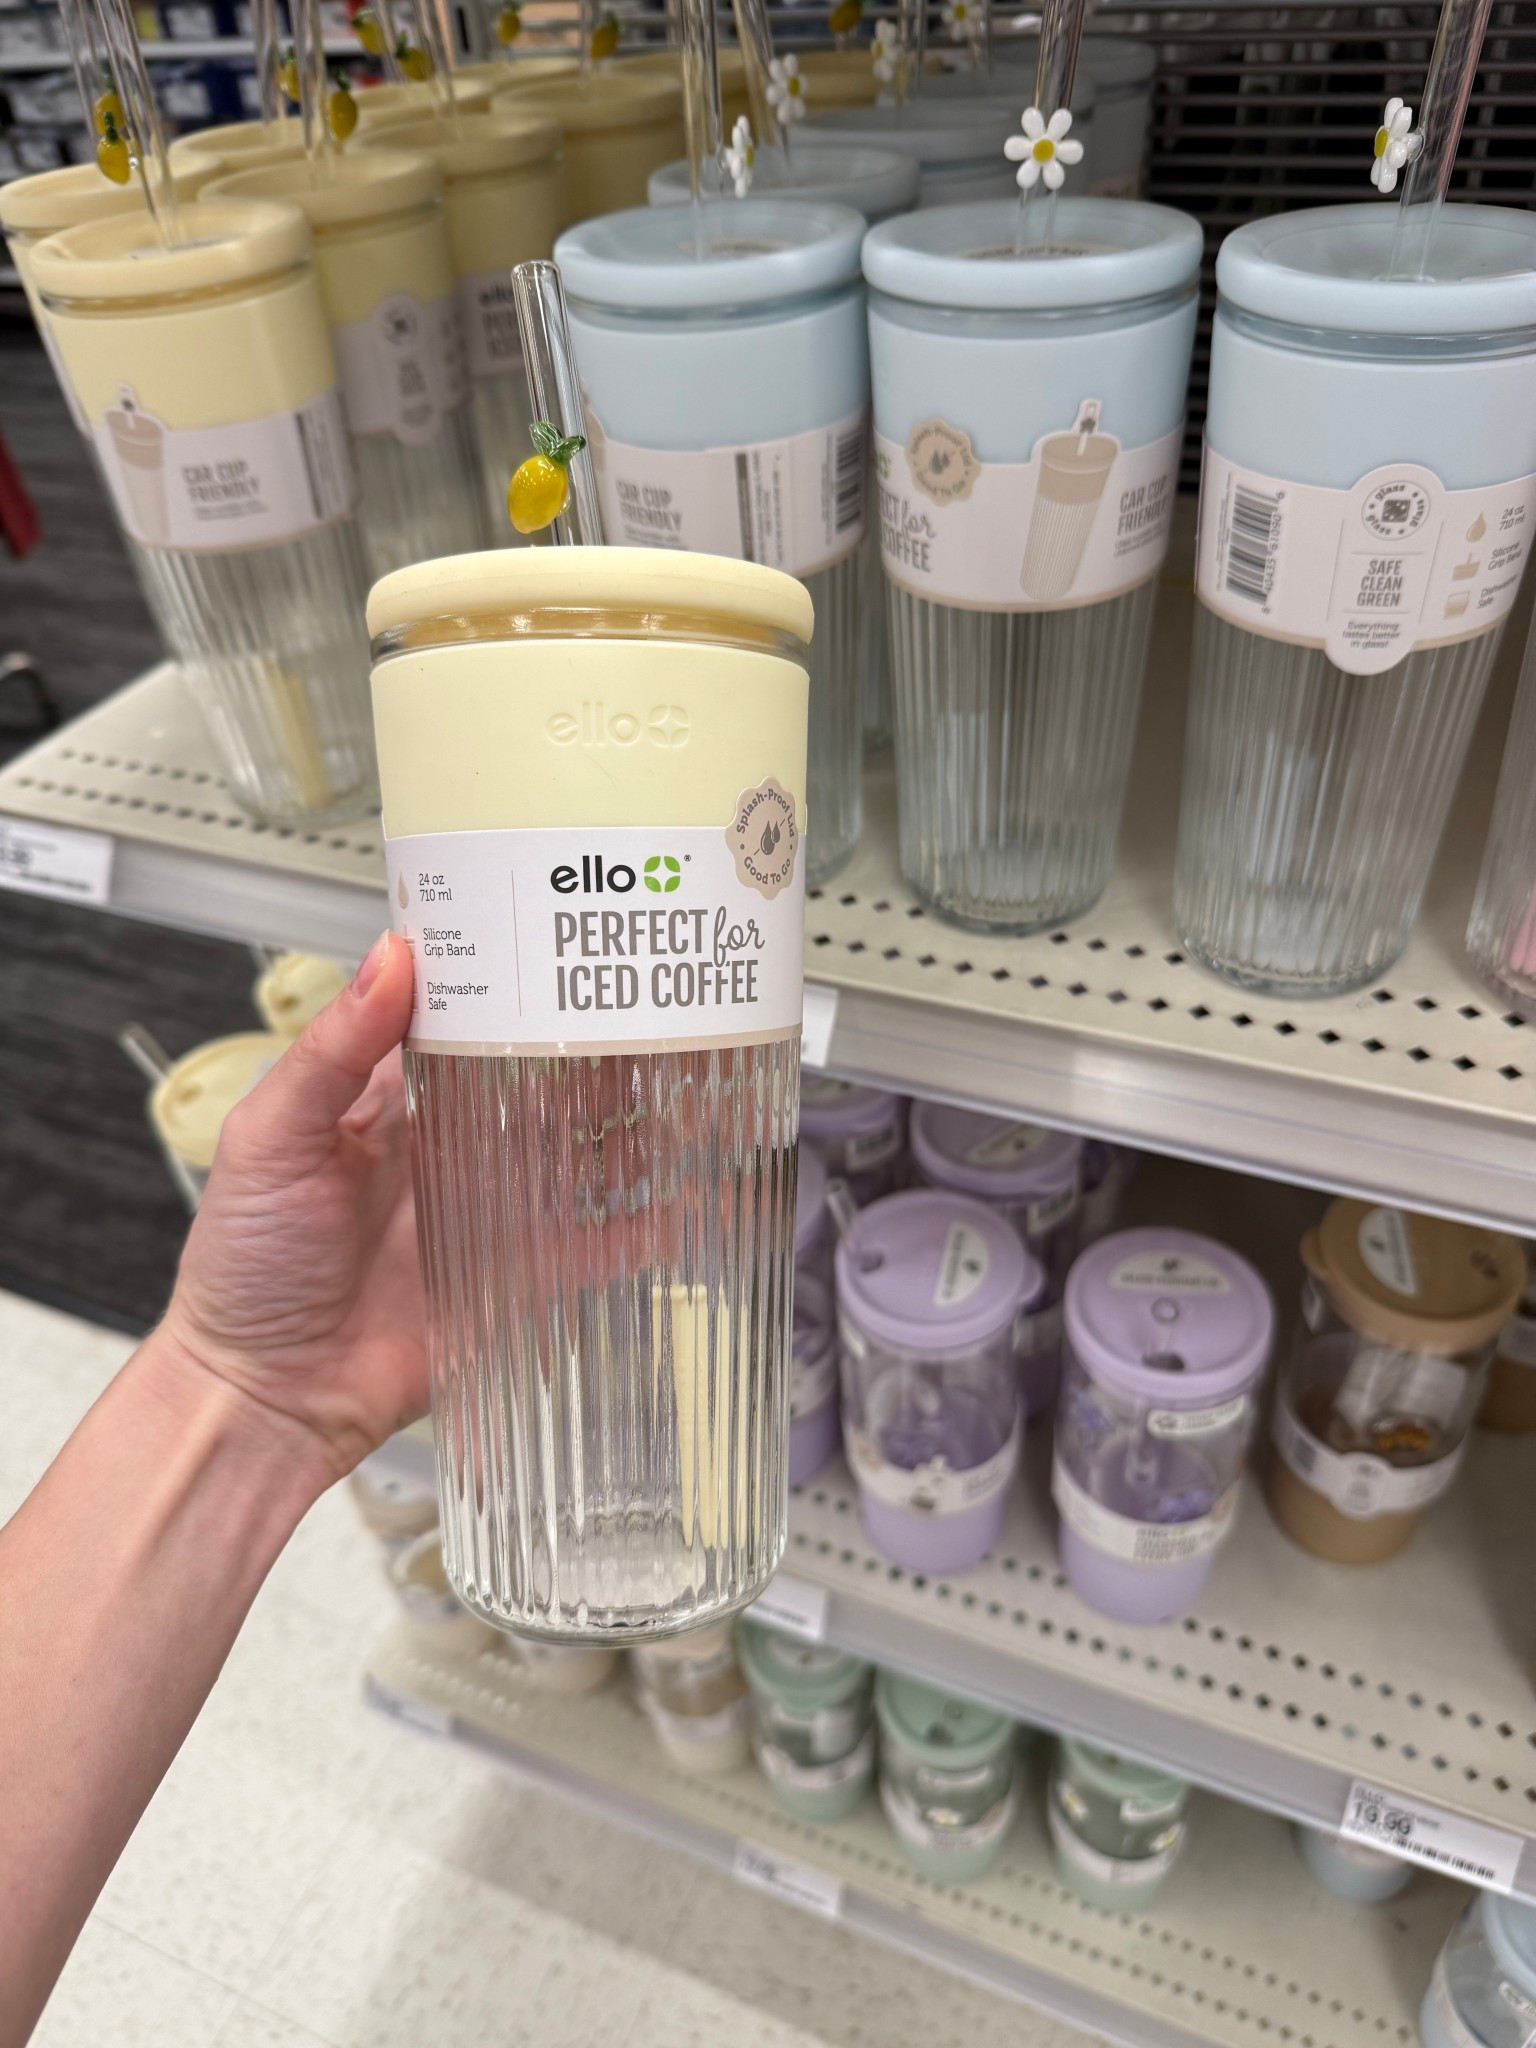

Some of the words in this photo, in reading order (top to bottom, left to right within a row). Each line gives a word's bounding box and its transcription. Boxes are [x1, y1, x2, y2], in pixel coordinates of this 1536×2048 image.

[1368, 560, 1403, 576] SAFE
[1360, 576, 1403, 592] CLEAN
[1356, 592, 1401, 607] GREEN
[545, 701, 641, 746] ello
[737, 788, 791, 835] Splash-Proof
[786, 812, 796, 838] Lid
[550, 855, 637, 894] ello
[743, 856, 769, 885] Good
[770, 872, 781, 885] To
[781, 858, 791, 877] Go
[419, 873, 430, 885] 24
[432, 875, 445, 885] oz
[420, 889, 435, 902] 710
[438, 888, 453, 901] ml
[423, 928, 462, 940] Silicone
[554, 909, 708, 957] PERFECT
[713, 905, 766, 968] for
[424, 944, 444, 959] Grip
[446, 944, 476, 956] Band
[427, 982, 489, 996] Dishwasher
[556, 964, 639, 1011] ICED
[651, 959, 759, 1008] COFFEE
[428, 998, 448, 1010] Safe
